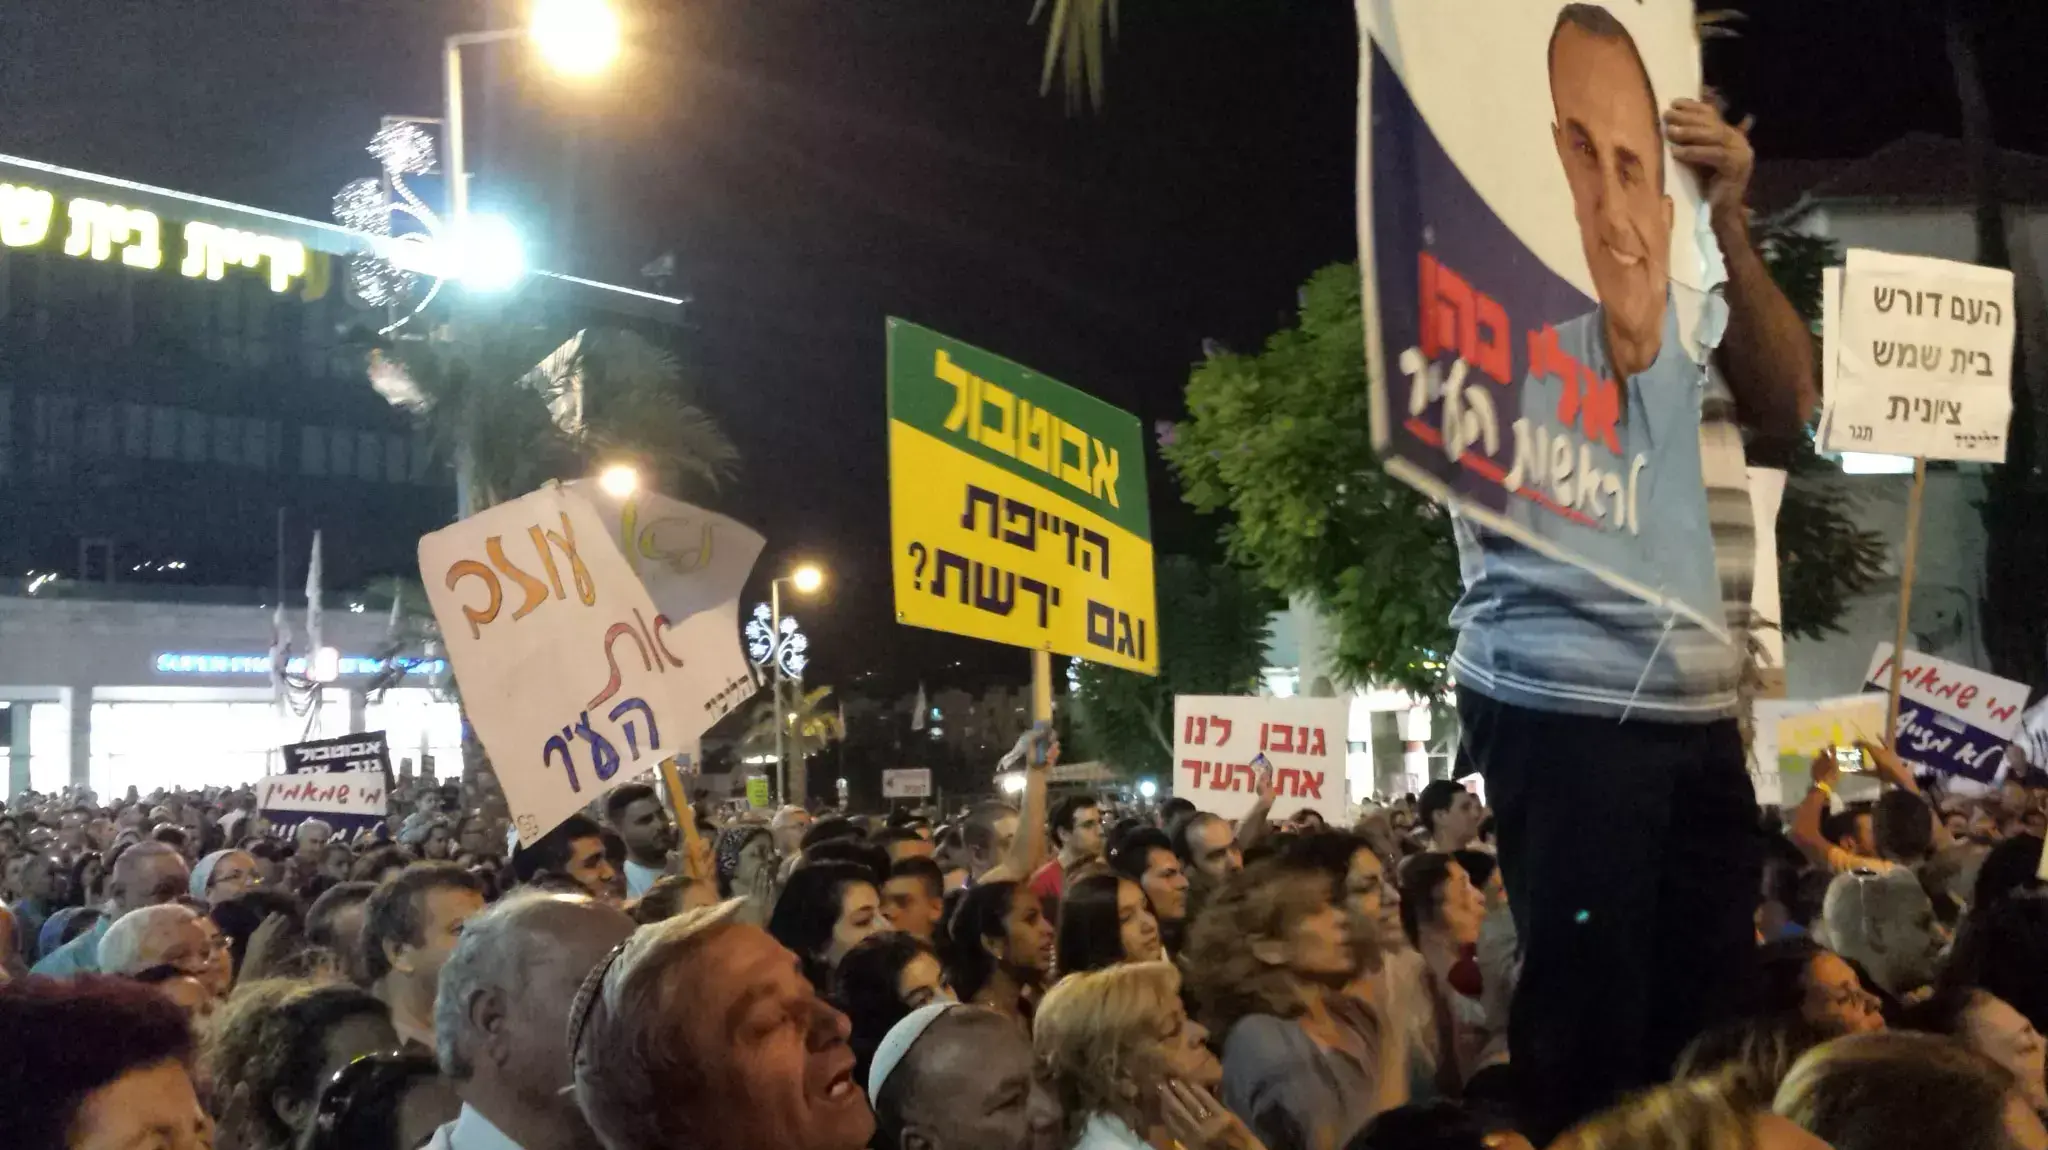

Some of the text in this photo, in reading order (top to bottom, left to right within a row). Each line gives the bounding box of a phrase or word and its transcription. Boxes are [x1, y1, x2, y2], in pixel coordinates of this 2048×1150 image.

[64, 198, 161, 269] בית
[1873, 285, 2002, 326] העם דורש
[1417, 250, 1622, 455] אלי כהן
[1872, 339, 1993, 377] בית שמש
[934, 348, 1120, 509] אבוטבול
[1399, 346, 1648, 536] לראשות העיר
[1885, 395, 1963, 426] ציונית
[960, 484, 1109, 580] הזייפת
[907, 541, 1146, 662] וגם ירשת?
[587, 607, 684, 711] את
[1871, 656, 2017, 722] מי שמאמן
[294, 741, 381, 763] אבוטבול
[543, 697, 661, 793] העיר
[1184, 715, 1327, 757] גנבו לנו
[1953, 741, 2004, 770] לא
[263, 781, 381, 809] מי שמאמין
[1181, 759, 1325, 799] את העיר
